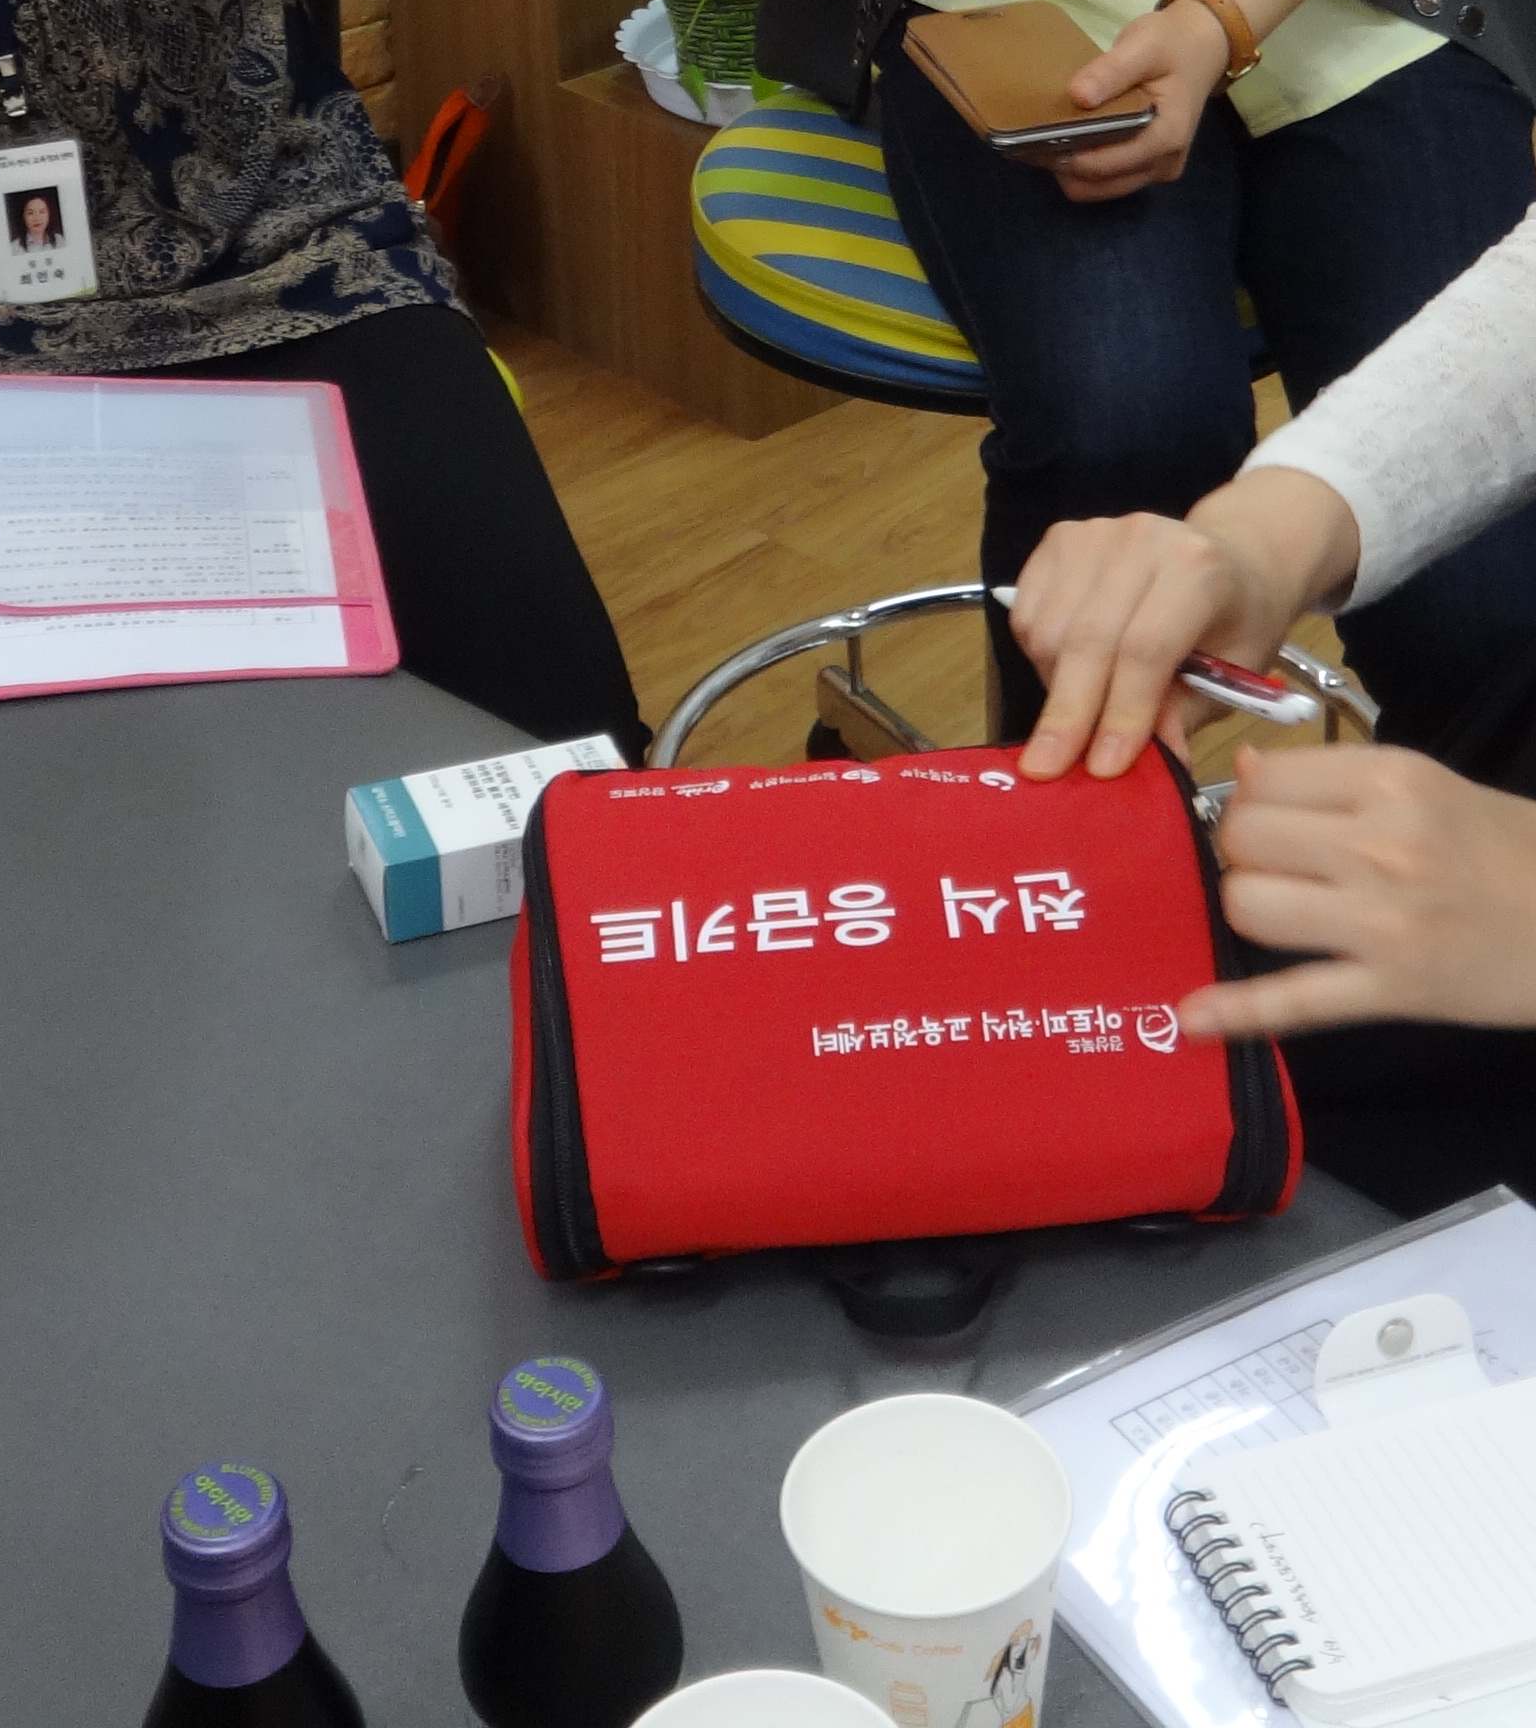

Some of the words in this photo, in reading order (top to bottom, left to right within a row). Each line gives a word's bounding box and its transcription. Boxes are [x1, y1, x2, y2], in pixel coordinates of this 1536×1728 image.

[589, 884, 897, 964] 응급키트
[938, 870, 1087, 939] 천식
[811, 1016, 972, 1057] 교육정보센터
[981, 1005, 1124, 1041] 아토피·천식
[1065, 1036, 1125, 1054] 경상북도
